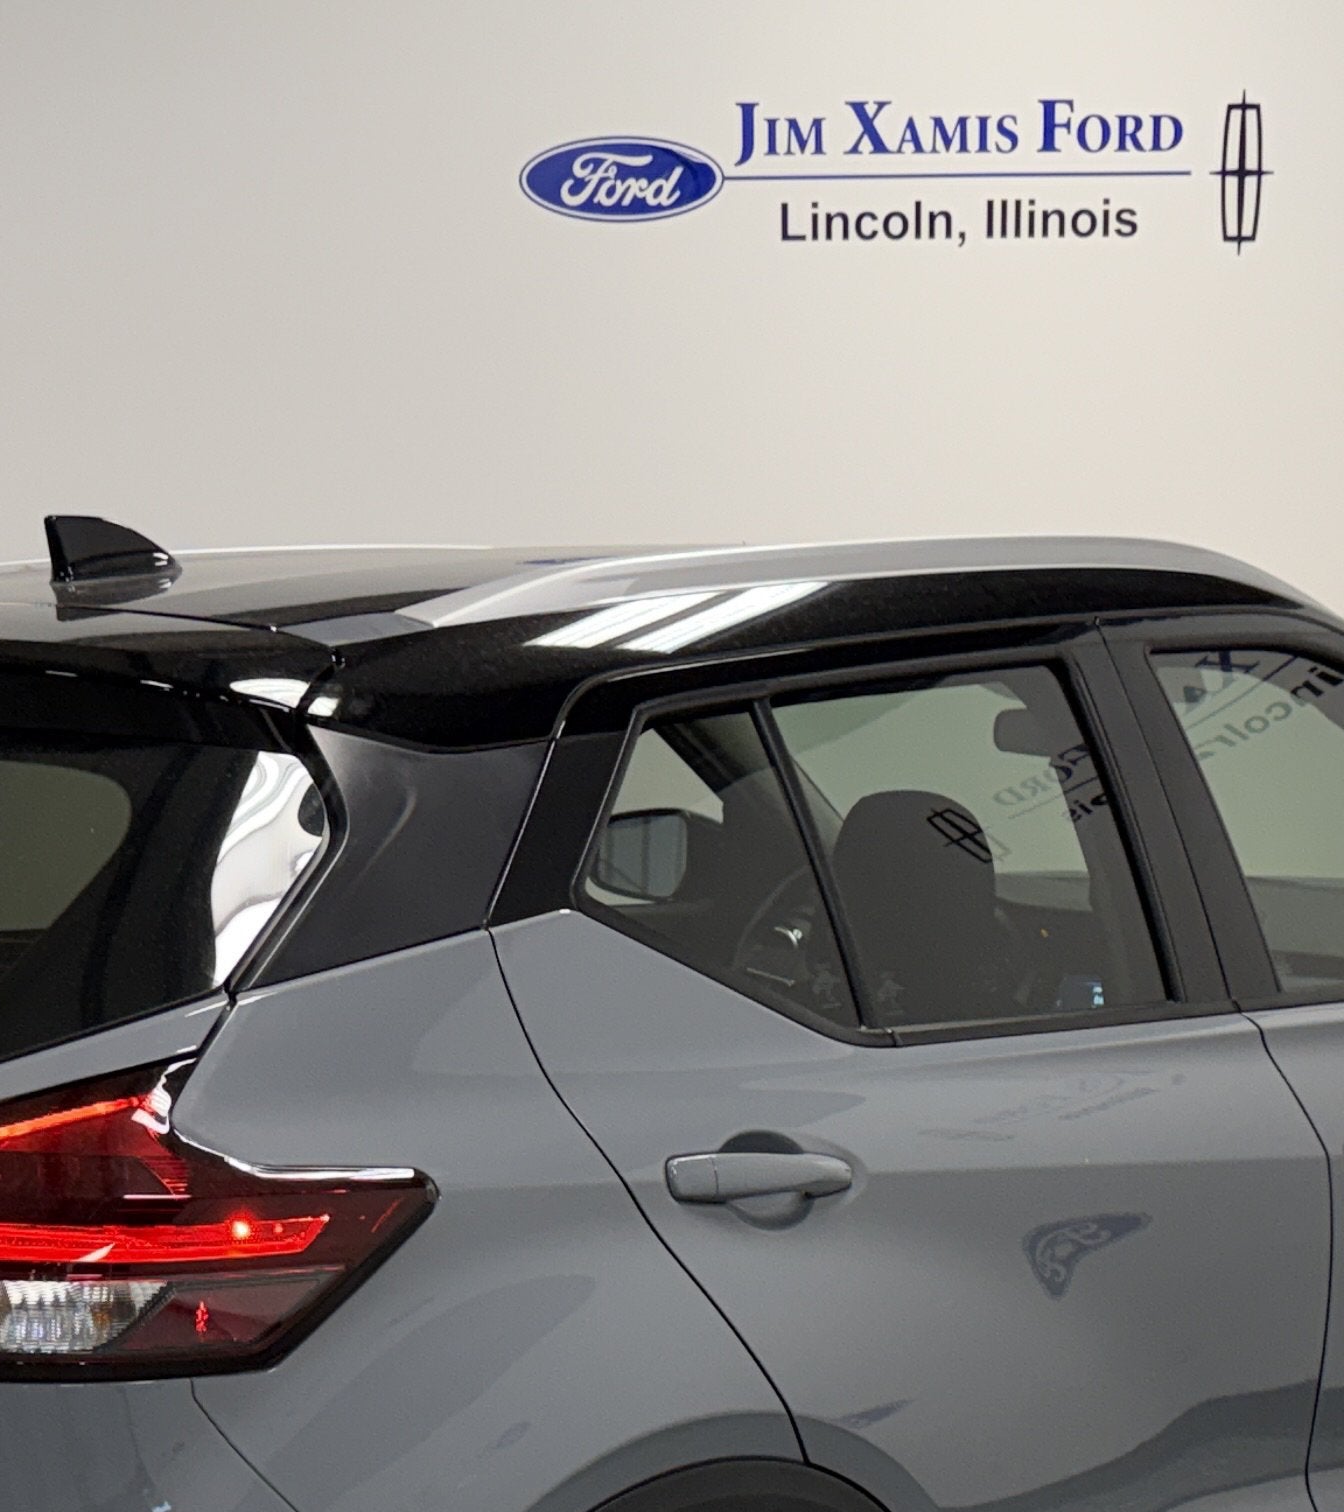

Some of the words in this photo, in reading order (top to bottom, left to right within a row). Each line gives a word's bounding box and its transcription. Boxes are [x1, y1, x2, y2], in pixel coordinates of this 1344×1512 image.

[734, 102, 826, 167] JIM
[843, 100, 1019, 155] XAMIS
[1036, 99, 1184, 153] FORD
[560, 147, 681, 209] Ford
[780, 200, 966, 247] Lincoln,
[986, 198, 1138, 239] Illinois
